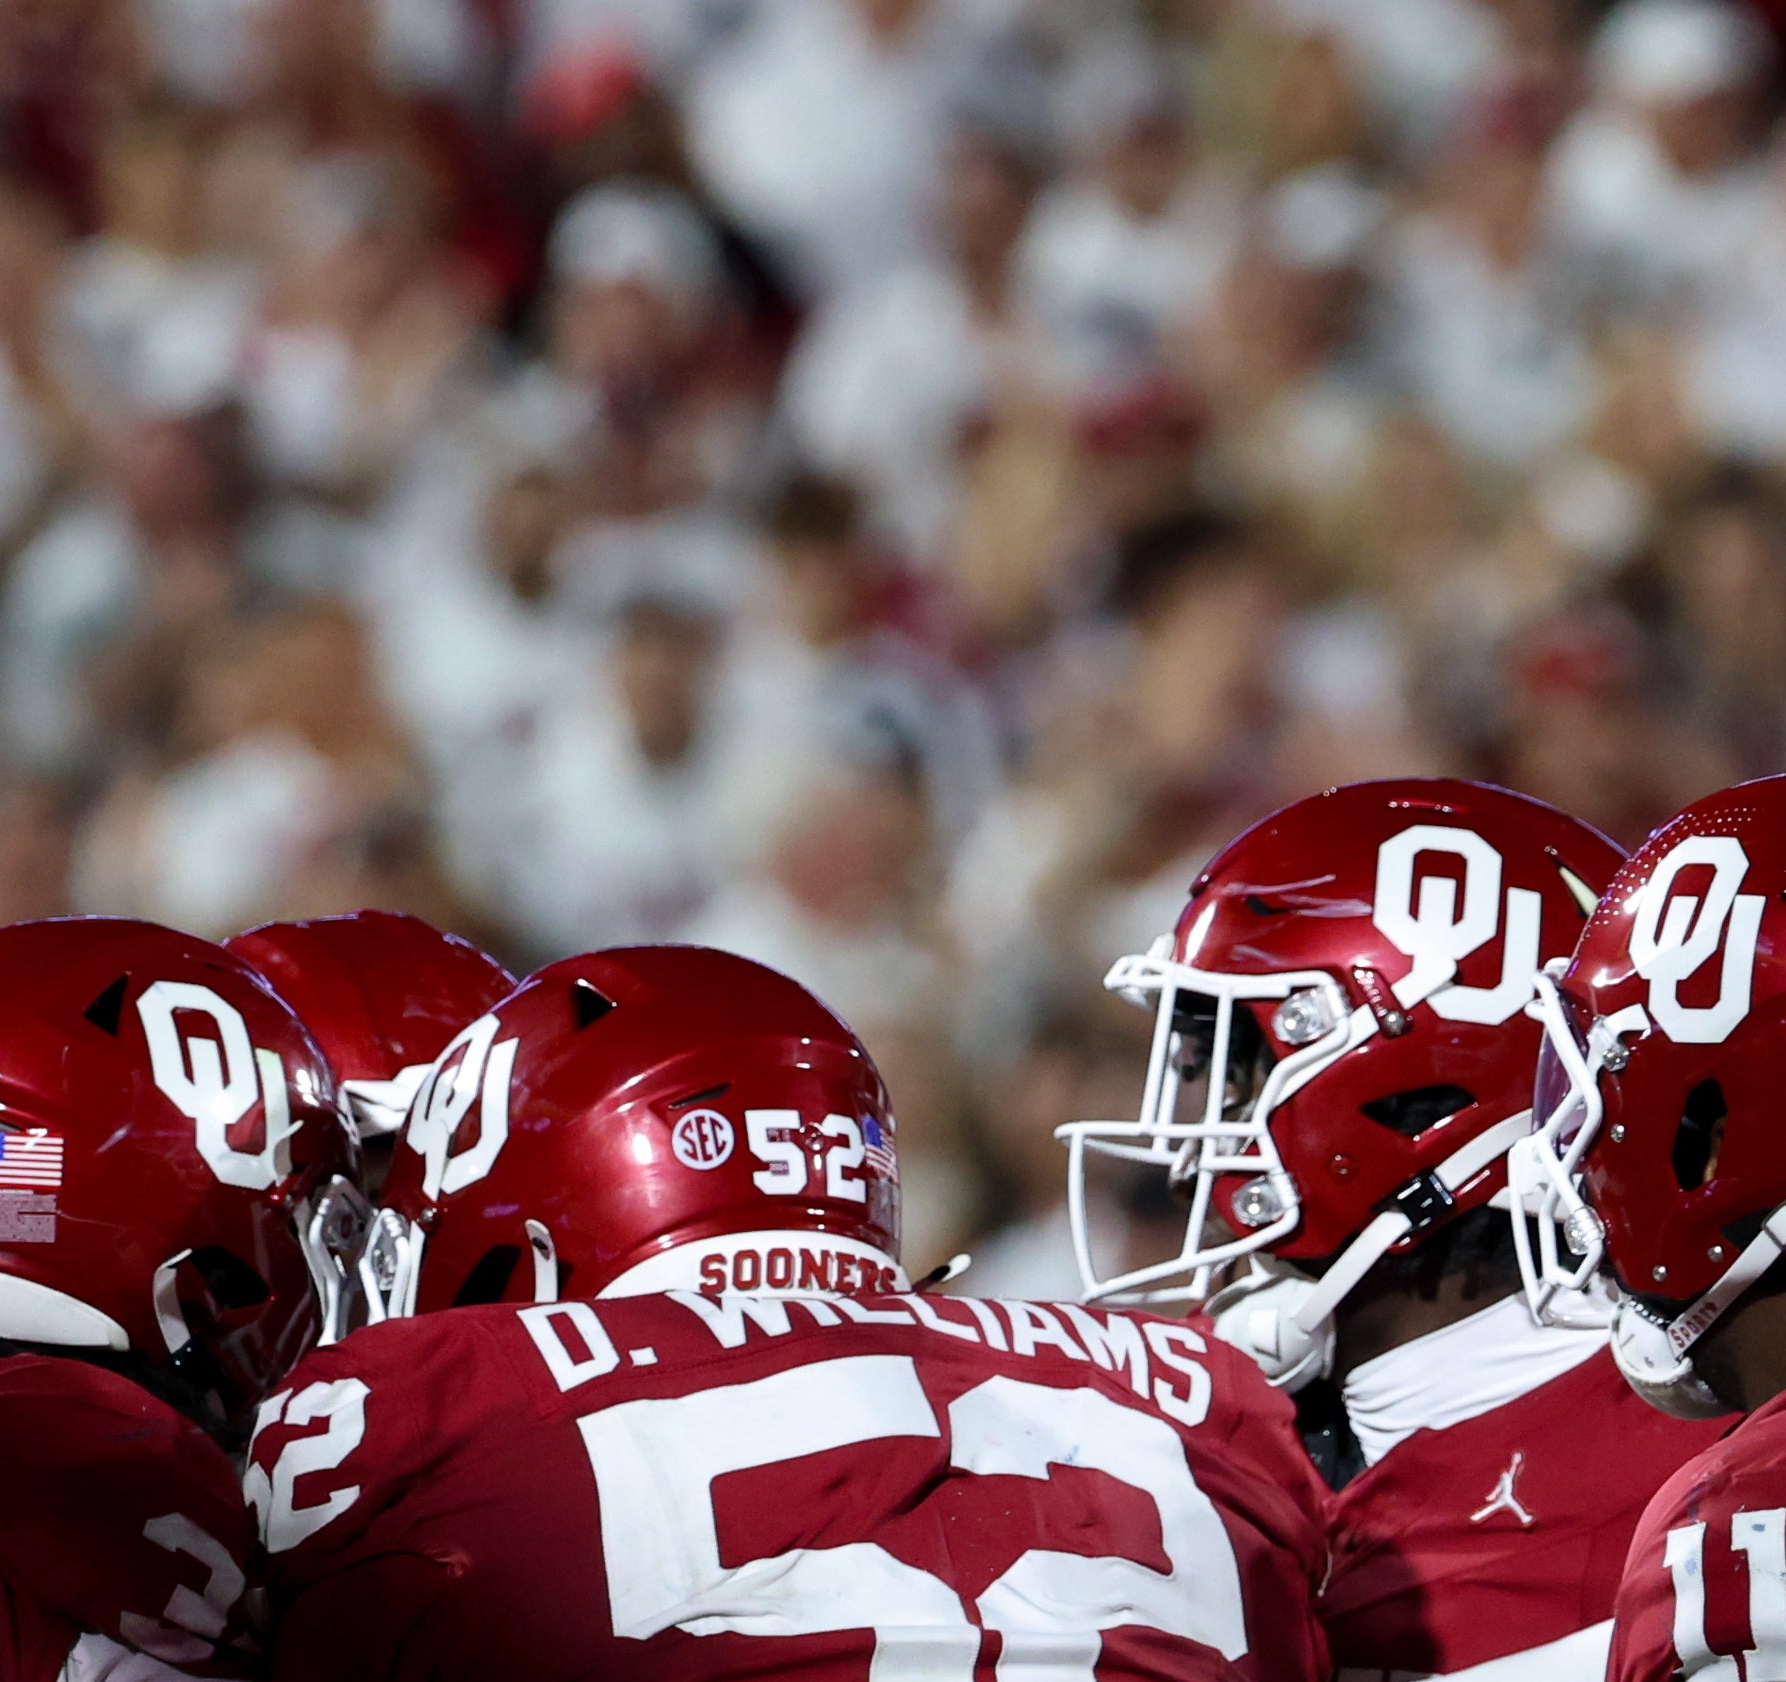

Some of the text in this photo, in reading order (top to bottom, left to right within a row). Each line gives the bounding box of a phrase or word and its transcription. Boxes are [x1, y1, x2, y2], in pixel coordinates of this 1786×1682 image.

[1372, 825, 1542, 1026] OU
[1628, 835, 1766, 1044] OU
[136, 981, 293, 1191] OU
[678, 1114, 728, 1163] SEC
[744, 1109, 866, 1204] 52
[698, 1247, 898, 1298] SOONERS
[516, 1290, 1213, 1428] D. WILLIAMS
[242, 1377, 373, 1555] 52
